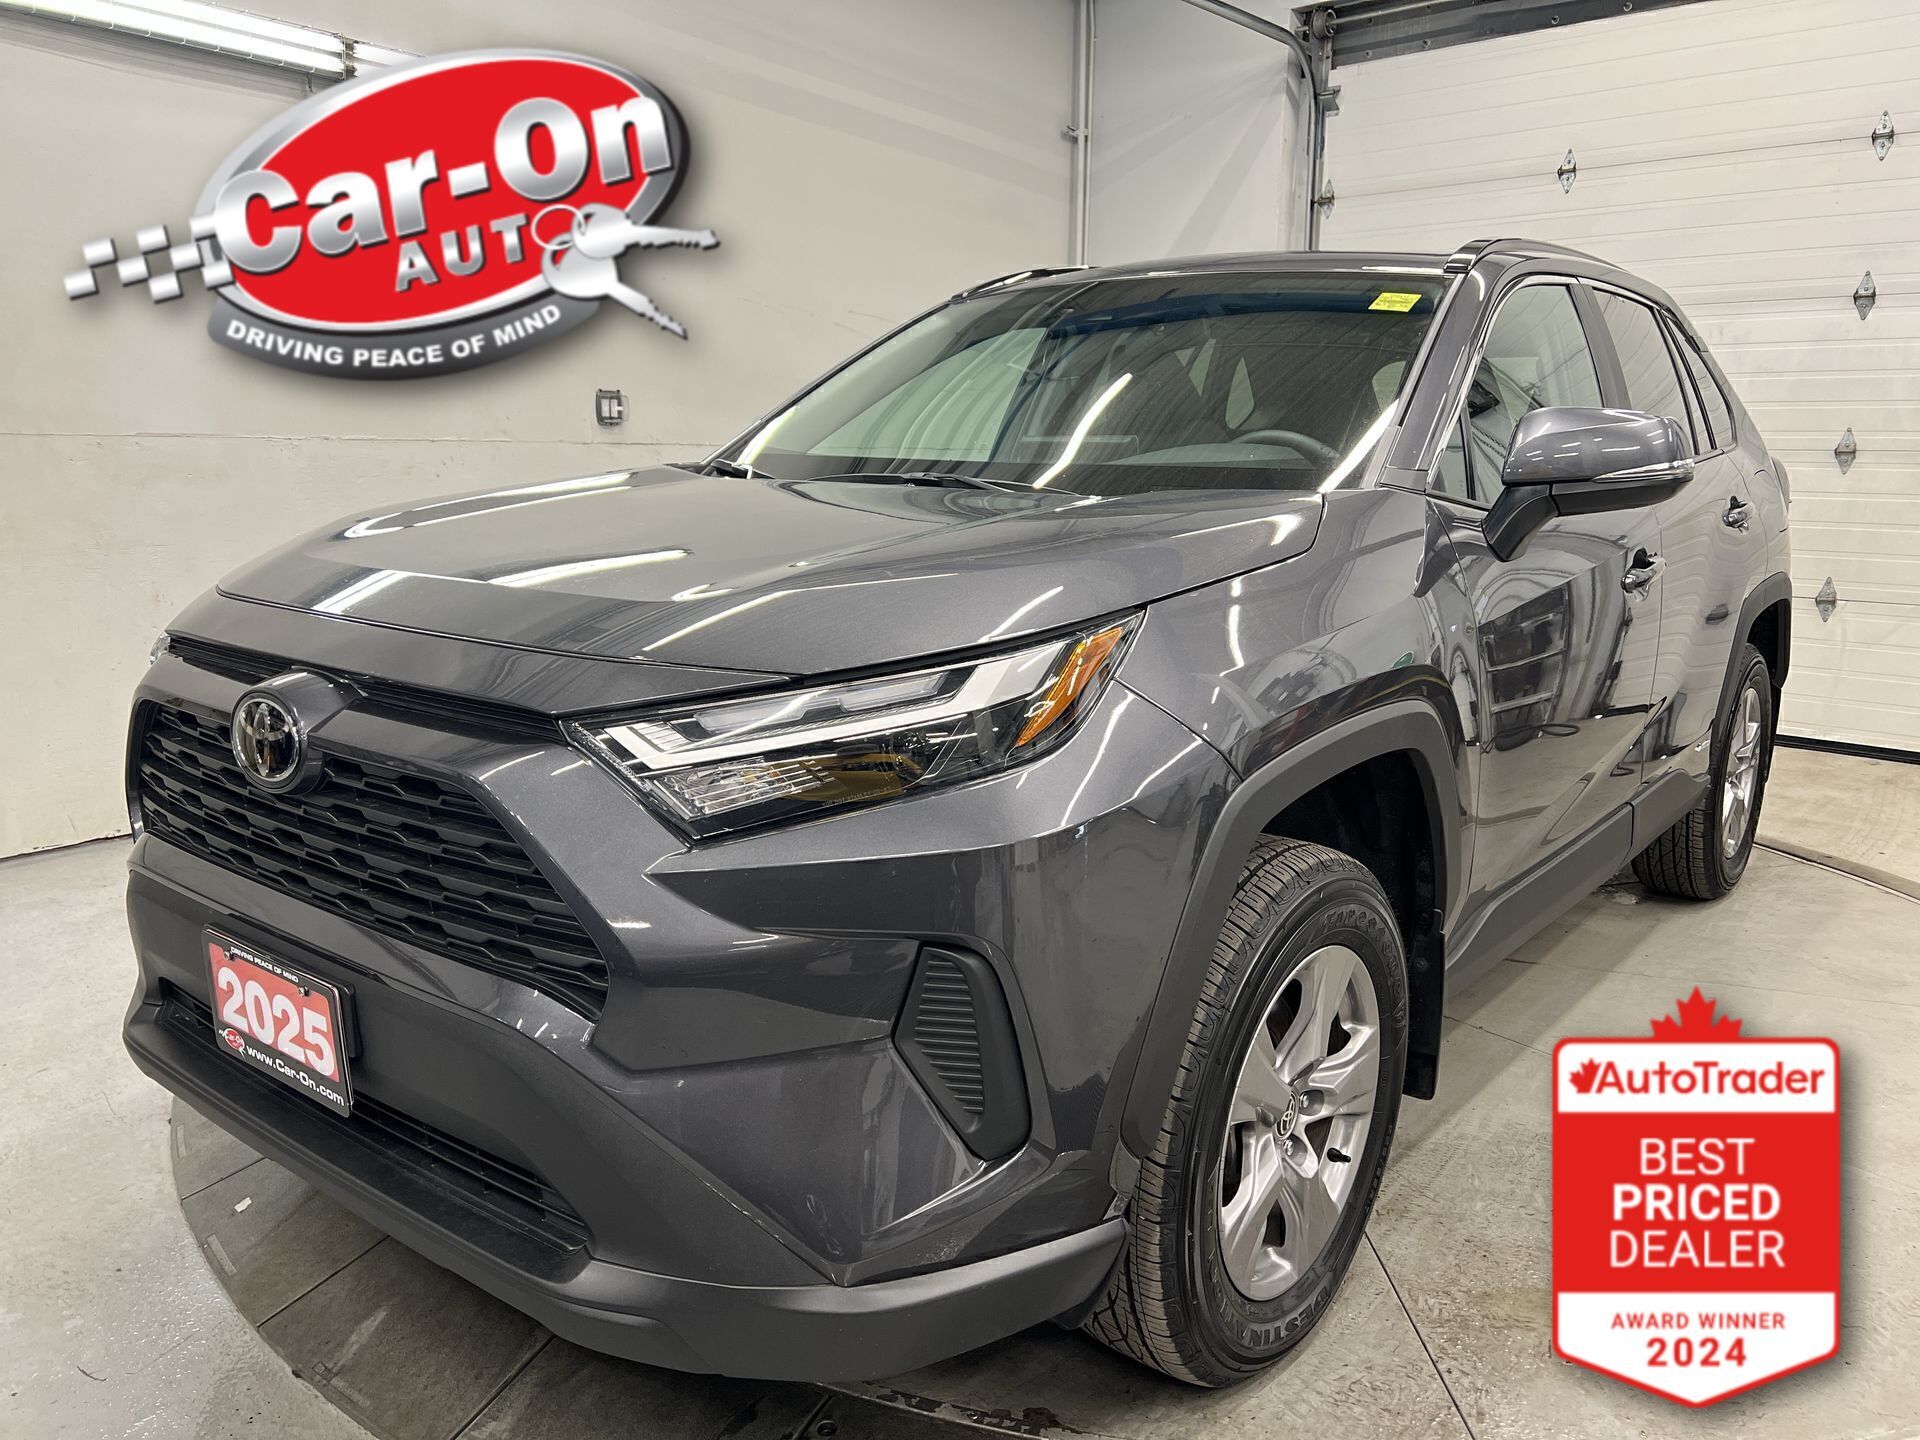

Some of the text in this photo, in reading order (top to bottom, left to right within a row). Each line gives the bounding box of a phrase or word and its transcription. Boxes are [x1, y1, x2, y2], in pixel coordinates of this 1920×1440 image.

[230, 946, 299, 983] DRIVING PEACE OF MIND
[217, 966, 335, 1077] 2025
[246, 1045, 345, 1106] www.Car-On.com
